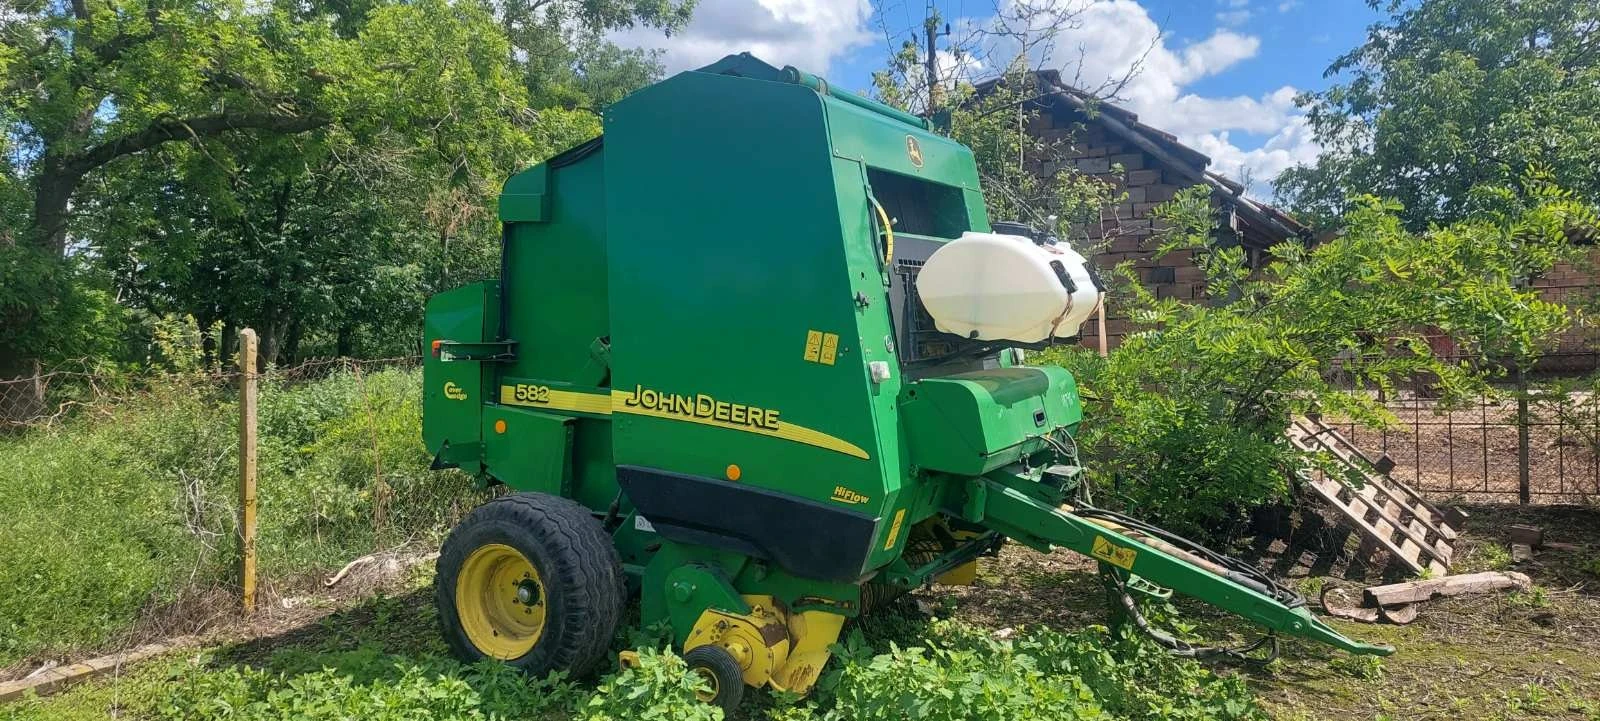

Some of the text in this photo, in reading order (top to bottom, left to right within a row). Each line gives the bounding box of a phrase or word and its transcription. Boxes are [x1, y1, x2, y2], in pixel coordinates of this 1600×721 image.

[516, 384, 550, 403] 582
[626, 384, 780, 429] JOHN DEERE
[833, 486, 870, 504] HiFlow
